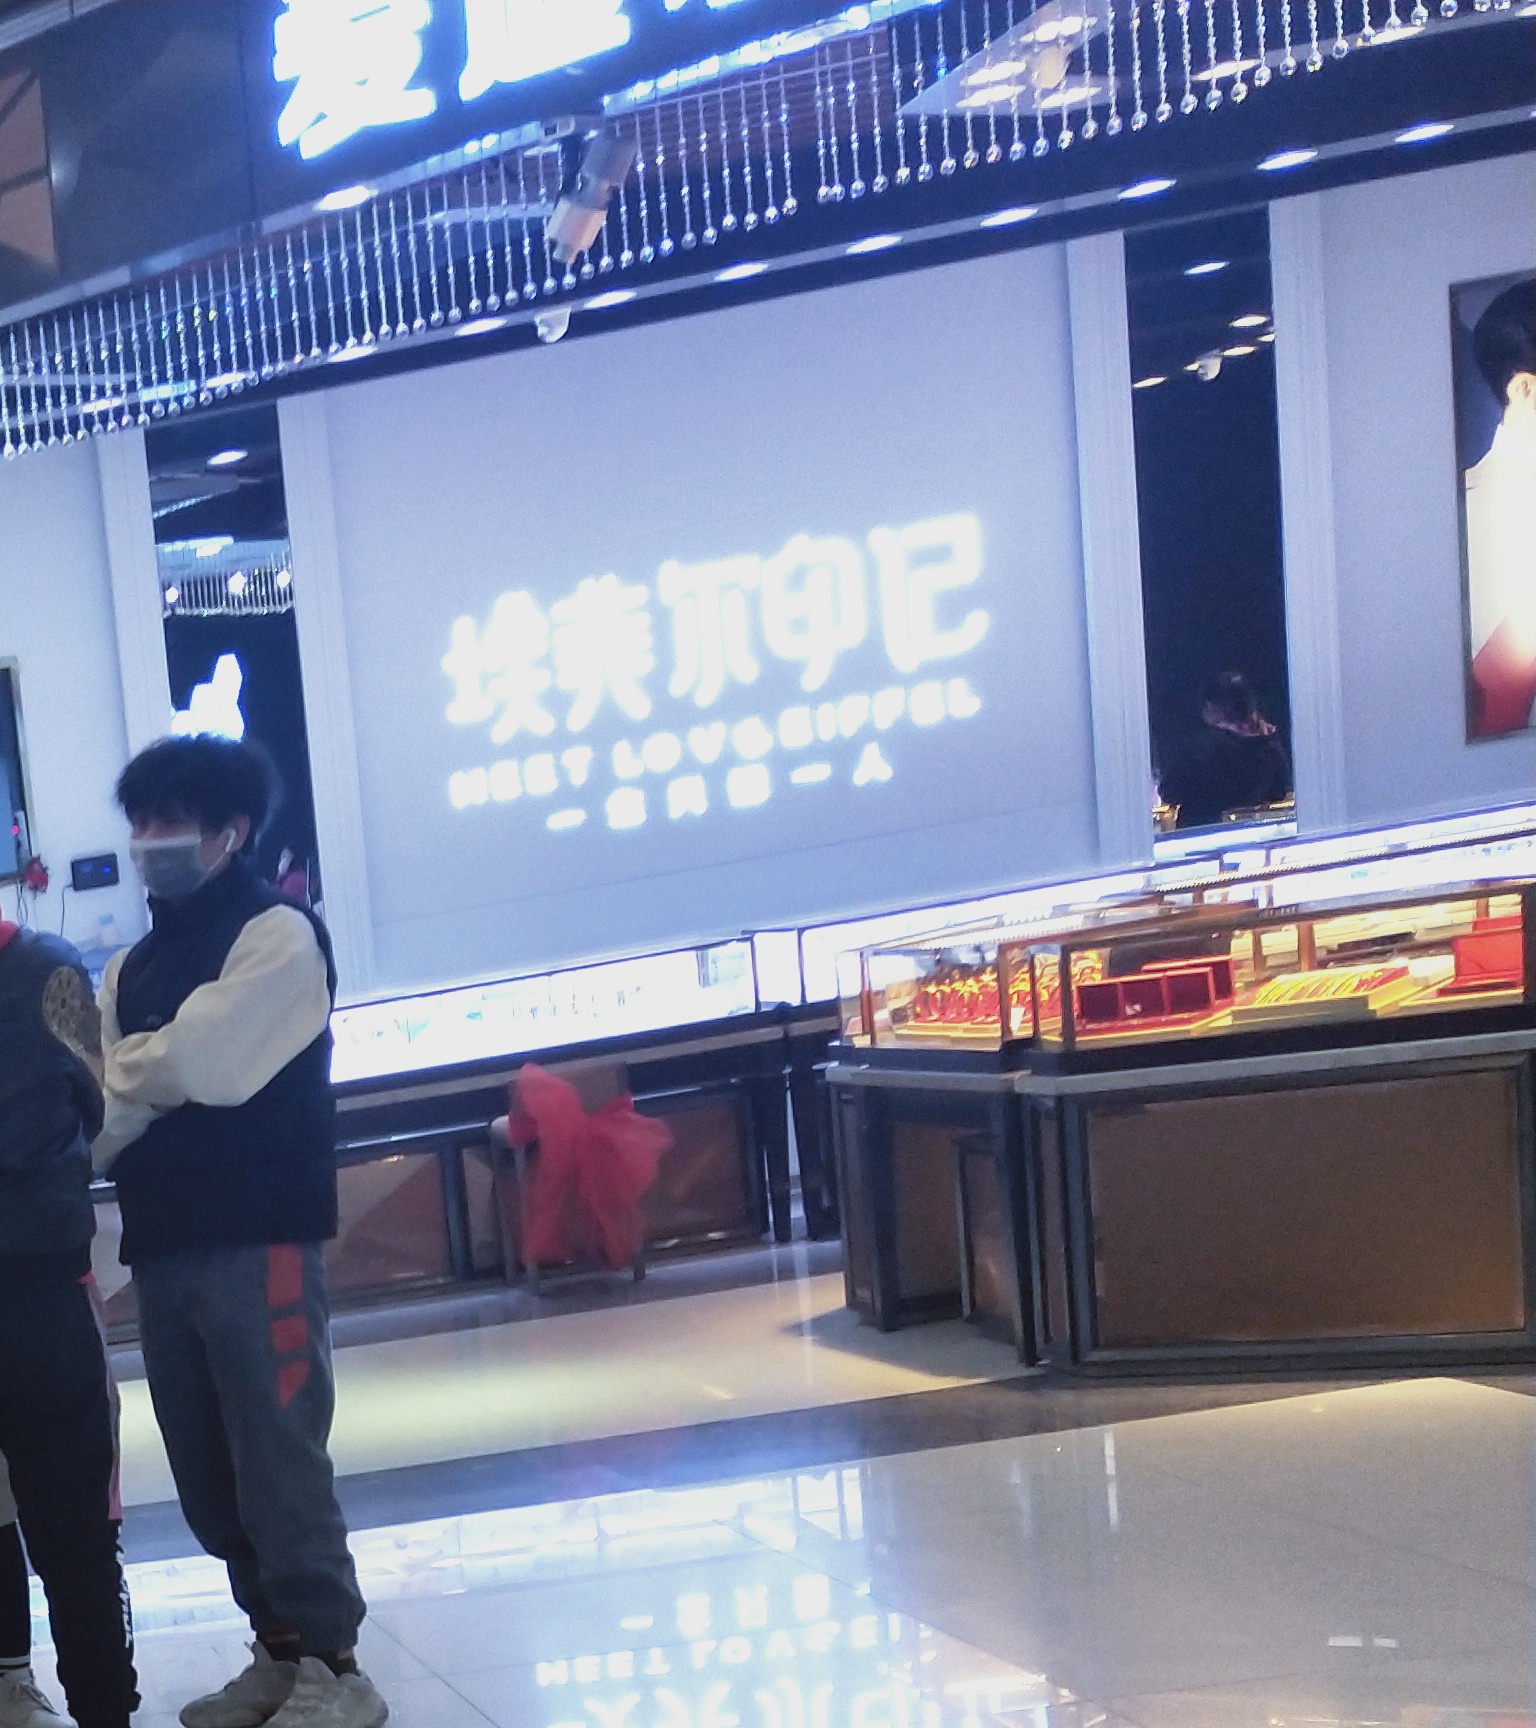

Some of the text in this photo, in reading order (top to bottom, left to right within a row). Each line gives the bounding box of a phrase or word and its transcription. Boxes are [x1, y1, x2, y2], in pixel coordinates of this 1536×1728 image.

[449, 677, 982, 810] MEET LOVE EIFFEL
